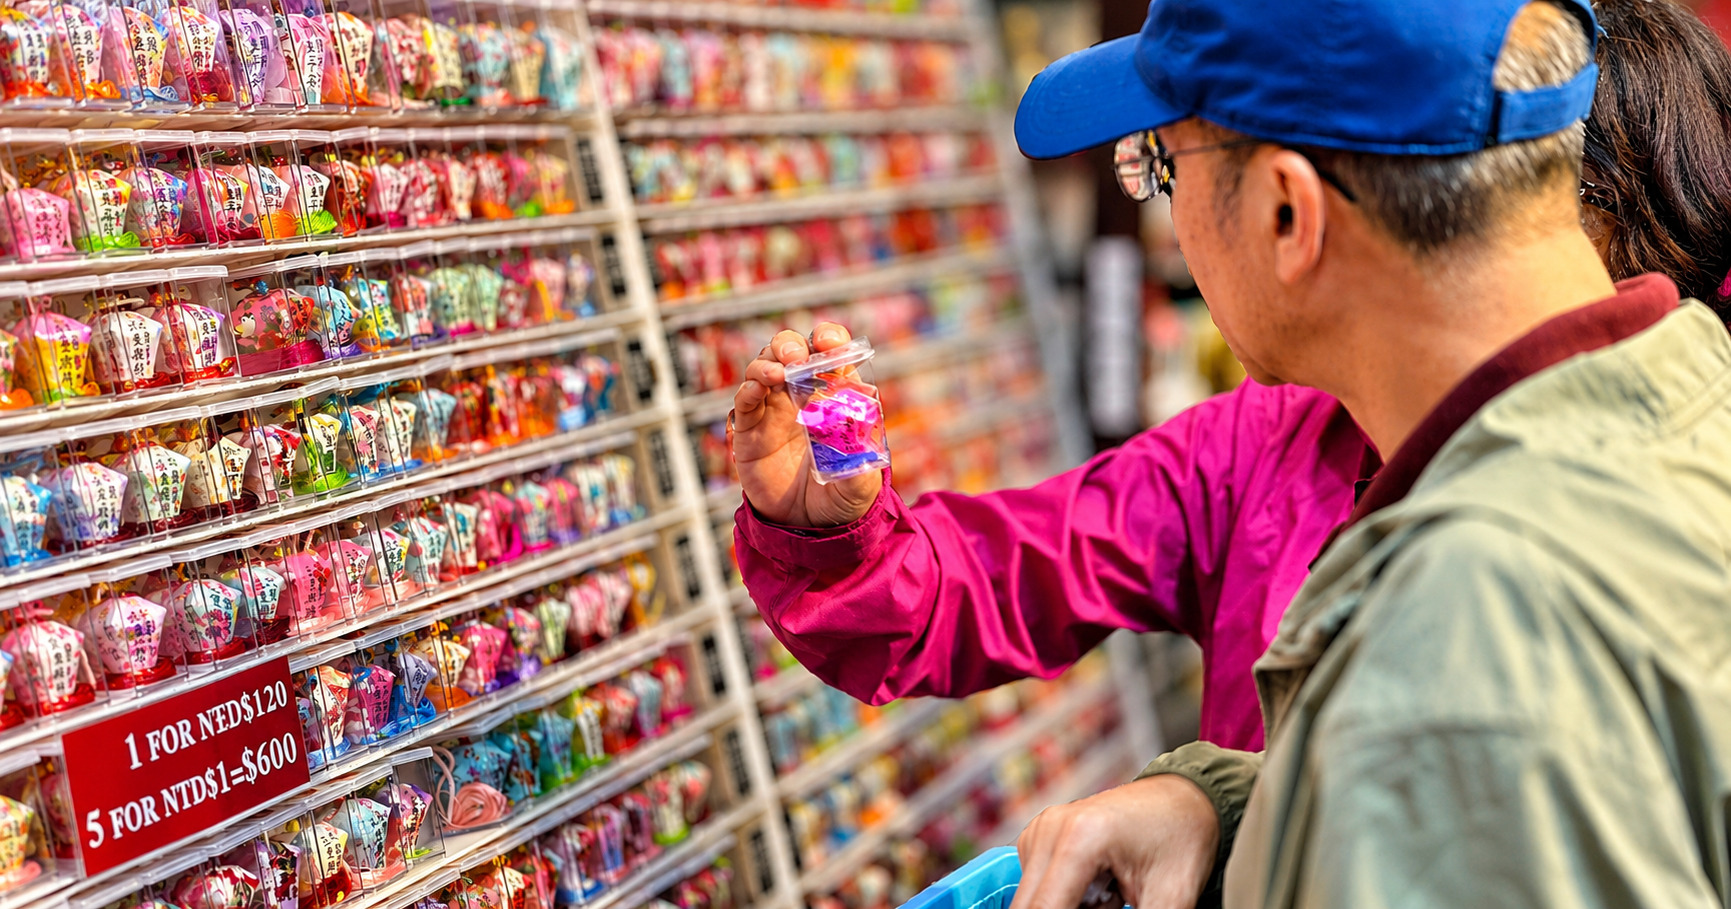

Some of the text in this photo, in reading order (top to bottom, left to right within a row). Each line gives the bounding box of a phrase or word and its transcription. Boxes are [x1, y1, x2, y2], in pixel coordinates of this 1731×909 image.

[125, 732, 143, 770] 1
[146, 719, 197, 762] FOR
[86, 808, 105, 849] 5
[109, 795, 160, 840] FOR
